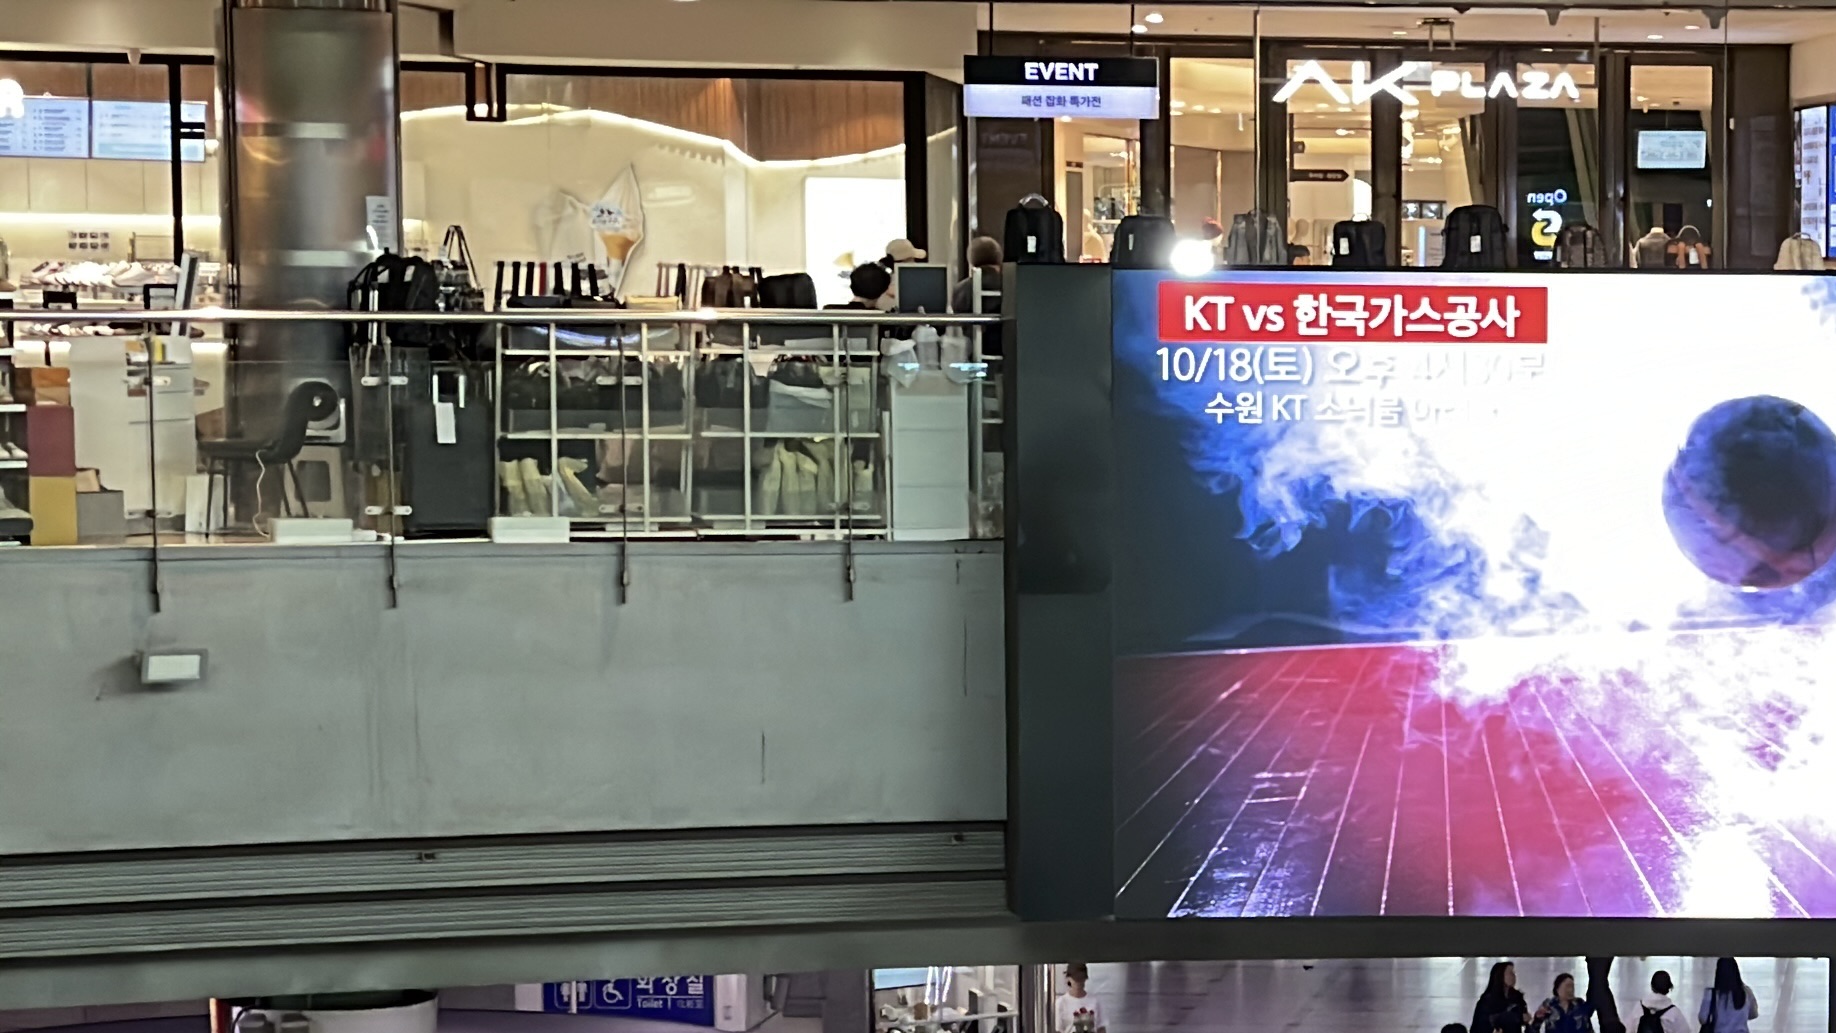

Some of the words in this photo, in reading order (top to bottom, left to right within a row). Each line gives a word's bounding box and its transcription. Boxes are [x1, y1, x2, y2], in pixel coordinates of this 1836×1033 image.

[1024, 62, 1099, 81] EVENT
[1272, 60, 1419, 105] AK
[1430, 69, 1580, 99] PLAZA
[1184, 296, 1234, 331] KT
[1243, 303, 1285, 332] vs
[1293, 294, 1521, 338] 한국가스공사
[1155, 346, 1313, 384] 10/18(토)
[1204, 391, 1263, 424] 수원
[1271, 394, 1309, 422] KT
